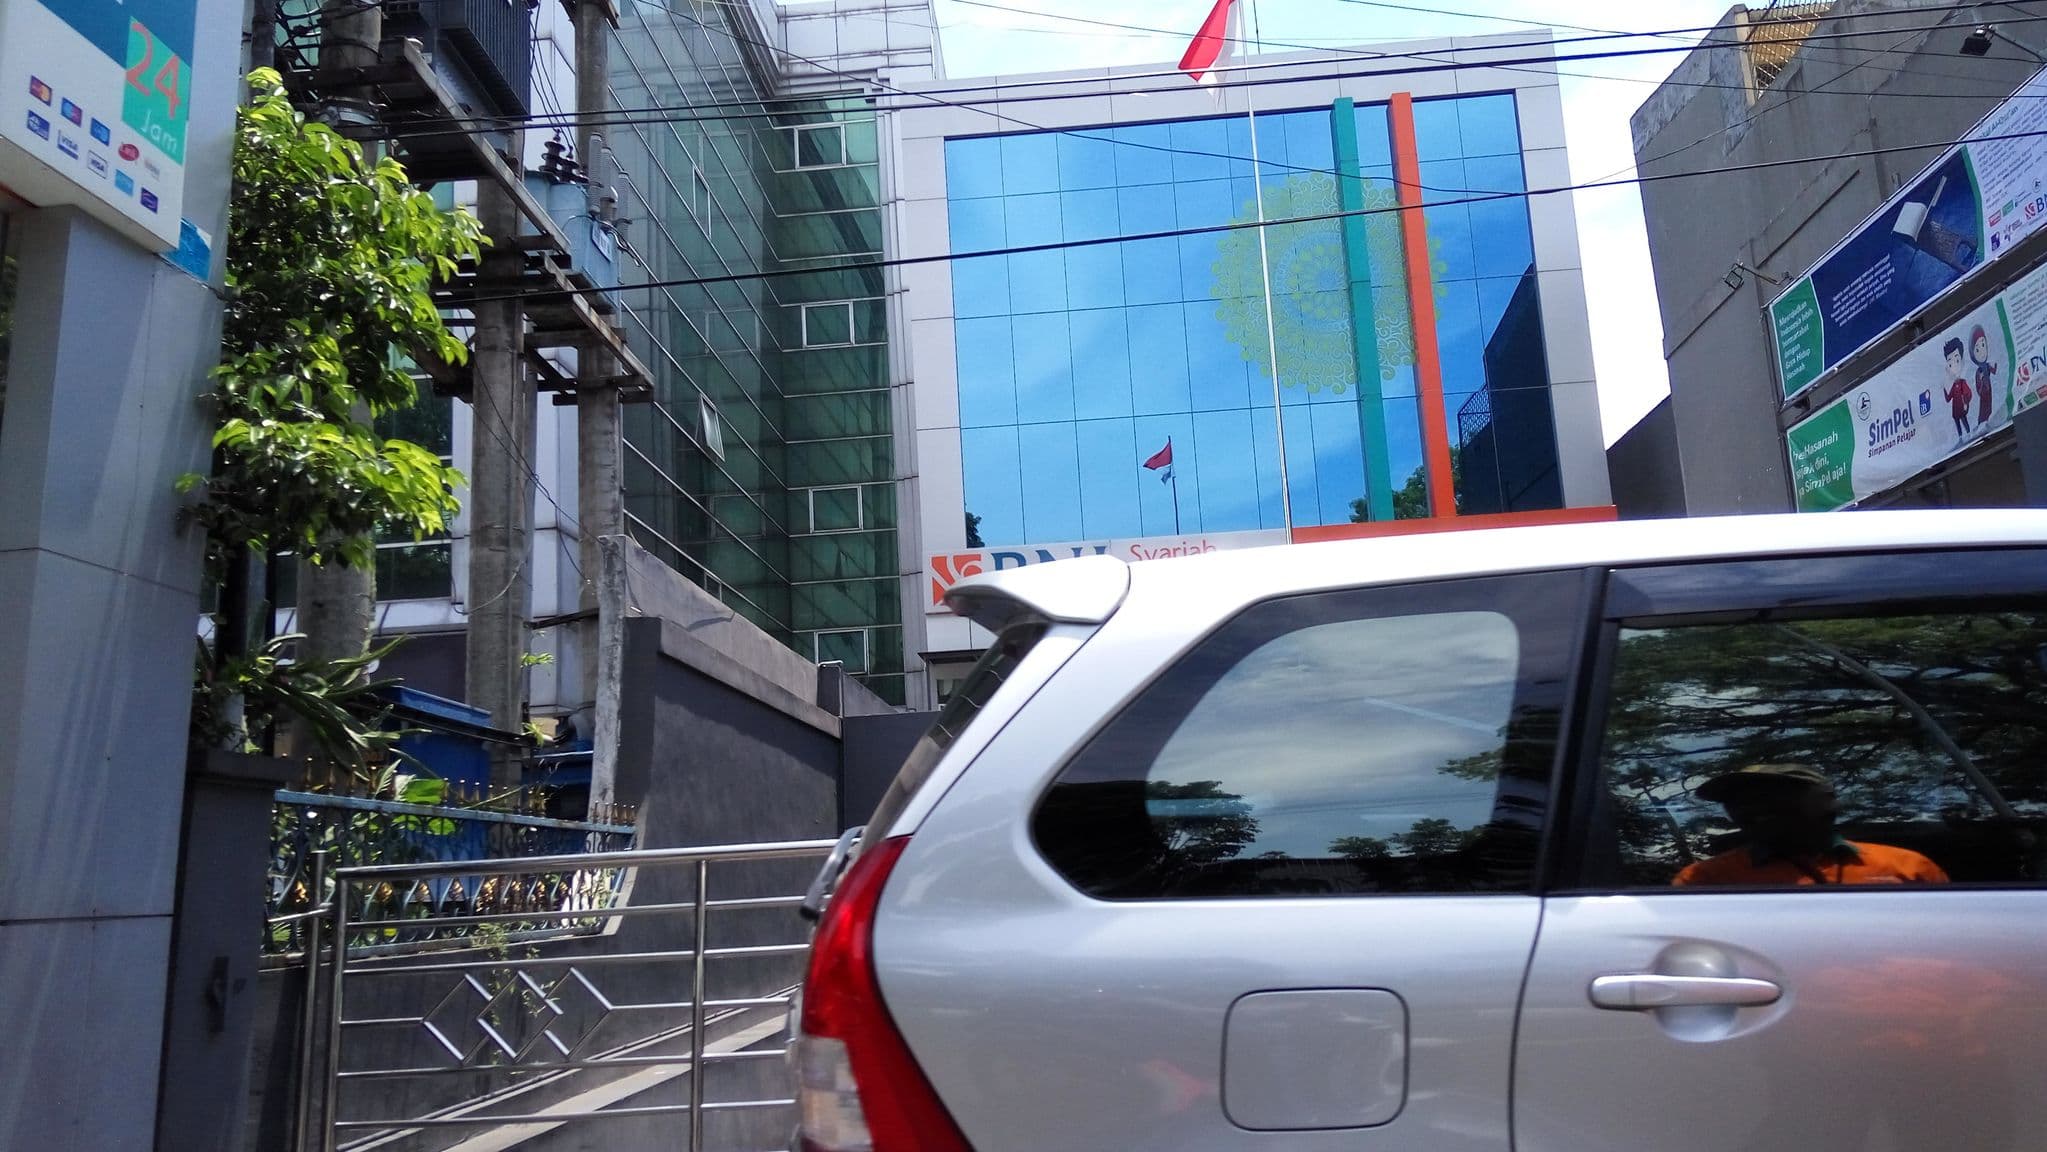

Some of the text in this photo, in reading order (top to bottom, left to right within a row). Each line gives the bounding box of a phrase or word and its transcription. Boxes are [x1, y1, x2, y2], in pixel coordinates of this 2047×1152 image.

[126, 22, 182, 119] 24
[140, 109, 177, 153] Jam
[1867, 428, 1916, 459] Simpanan Pelajar
[1868, 400, 1915, 447] SimPel
